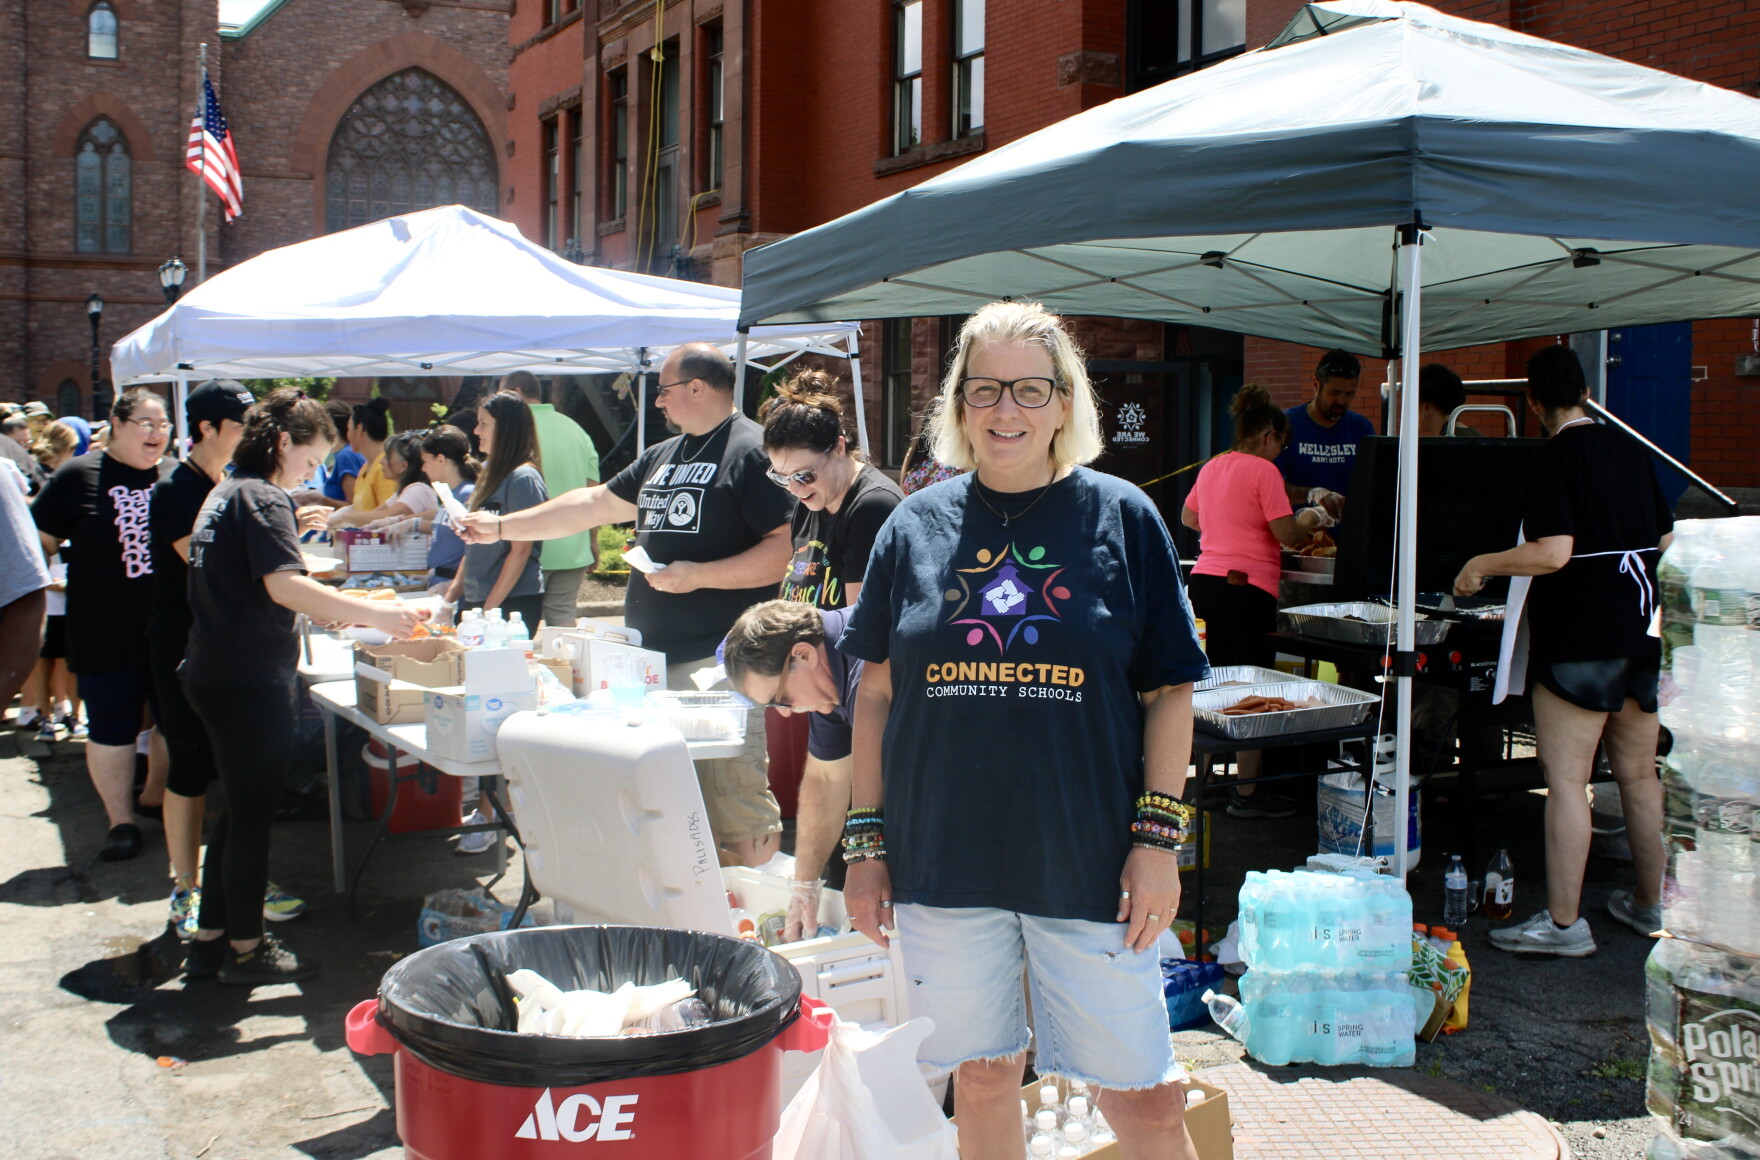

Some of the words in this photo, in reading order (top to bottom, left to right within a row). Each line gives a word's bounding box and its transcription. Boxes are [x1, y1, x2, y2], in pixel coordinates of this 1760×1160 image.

[1298, 442, 1356, 456] WELLESLEY
[668, 462, 717, 486] UNITED
[639, 493, 670, 509] United
[644, 510, 664, 529] Way
[926, 662, 1085, 687] CONNECTED
[926, 685, 1008, 698] COMMUNITY
[1018, 686, 1082, 702] SCHOOLS
[1338, 929, 1362, 937] SPRING
[1338, 1024, 1364, 1032] SPRING
[1682, 1022, 1760, 1062] Pola
[514, 1086, 640, 1143] ACE
